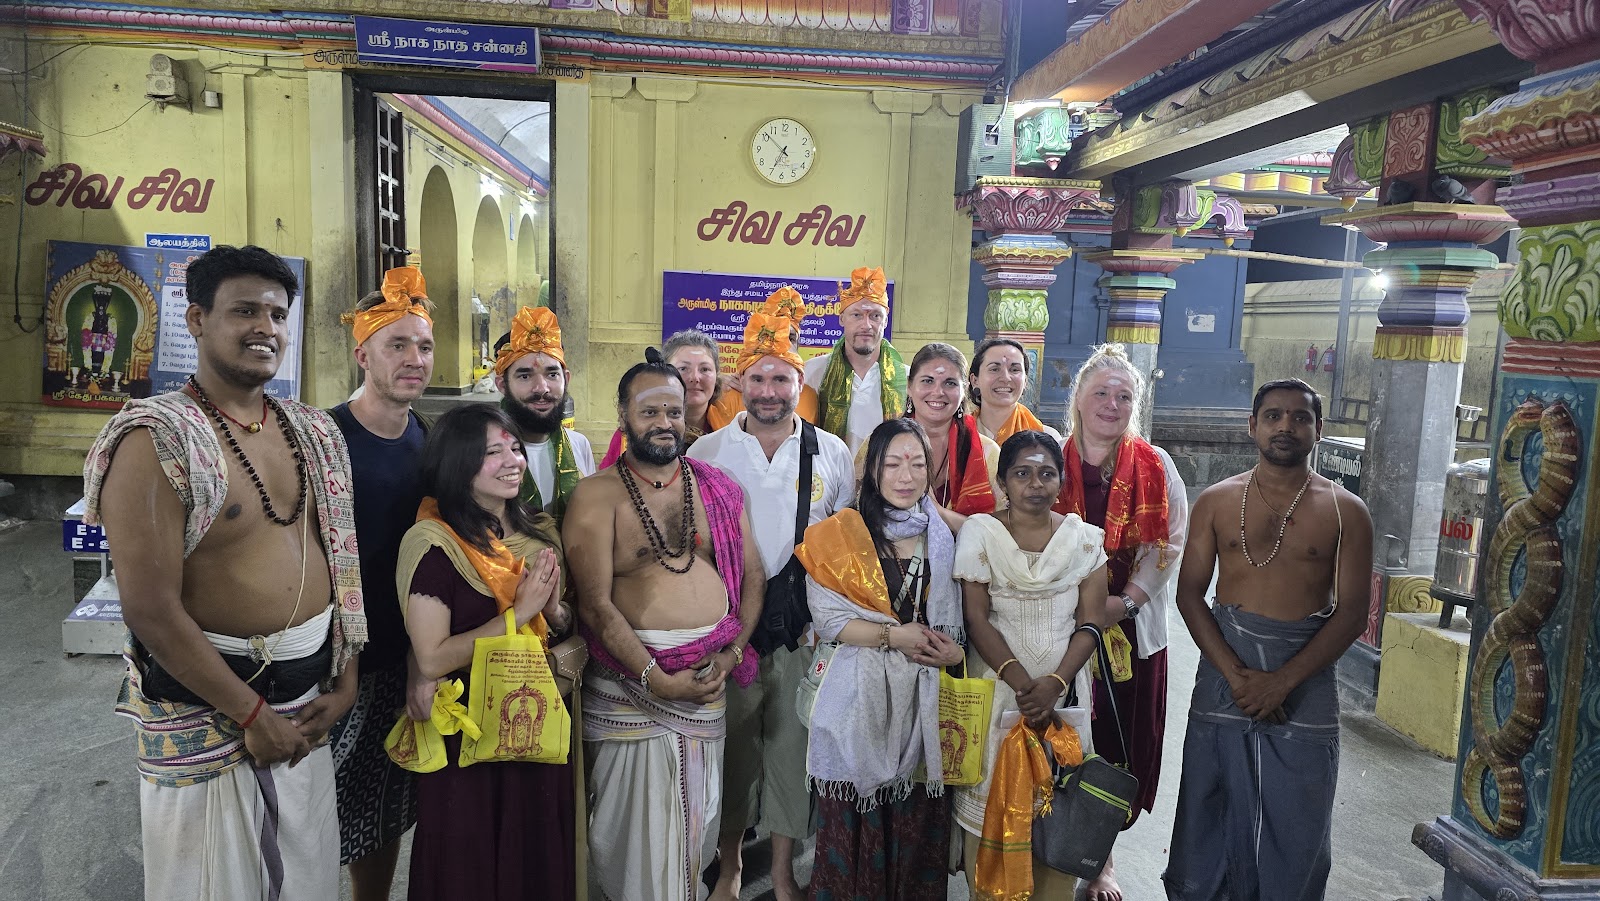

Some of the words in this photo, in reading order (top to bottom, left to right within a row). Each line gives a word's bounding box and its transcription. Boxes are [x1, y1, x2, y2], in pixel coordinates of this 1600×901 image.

[424, 26, 470, 35] அருள்மிகு
[367, 31, 391, 47] ஸ்ரீ
[394, 36, 430, 49] நாக
[432, 38, 469, 53] நாத
[472, 38, 528, 57] சன்னதி
[770, 126, 777, 135] 11
[782, 123, 789, 133] 12
[801, 137, 808, 146] 2
[756, 145, 762, 153] 9
[804, 149, 811, 158] 3
[759, 157, 765, 166] 8
[800, 161, 806, 170] 4
[769, 167, 775, 176] 7
[778, 171, 785, 180] 6
[790, 169, 797, 178] 5
[25, 163, 125, 211] சிவ
[126, 168, 215, 213] சிவ
[697, 201, 782, 244] சிவ
[783, 205, 866, 247] சிவ
[148, 237, 208, 249] ஆலயத்தில்
[720, 288, 743, 297] இந்து
[677, 297, 718, 311] அருள்மிகு
[68, 390, 92, 402] கேது
